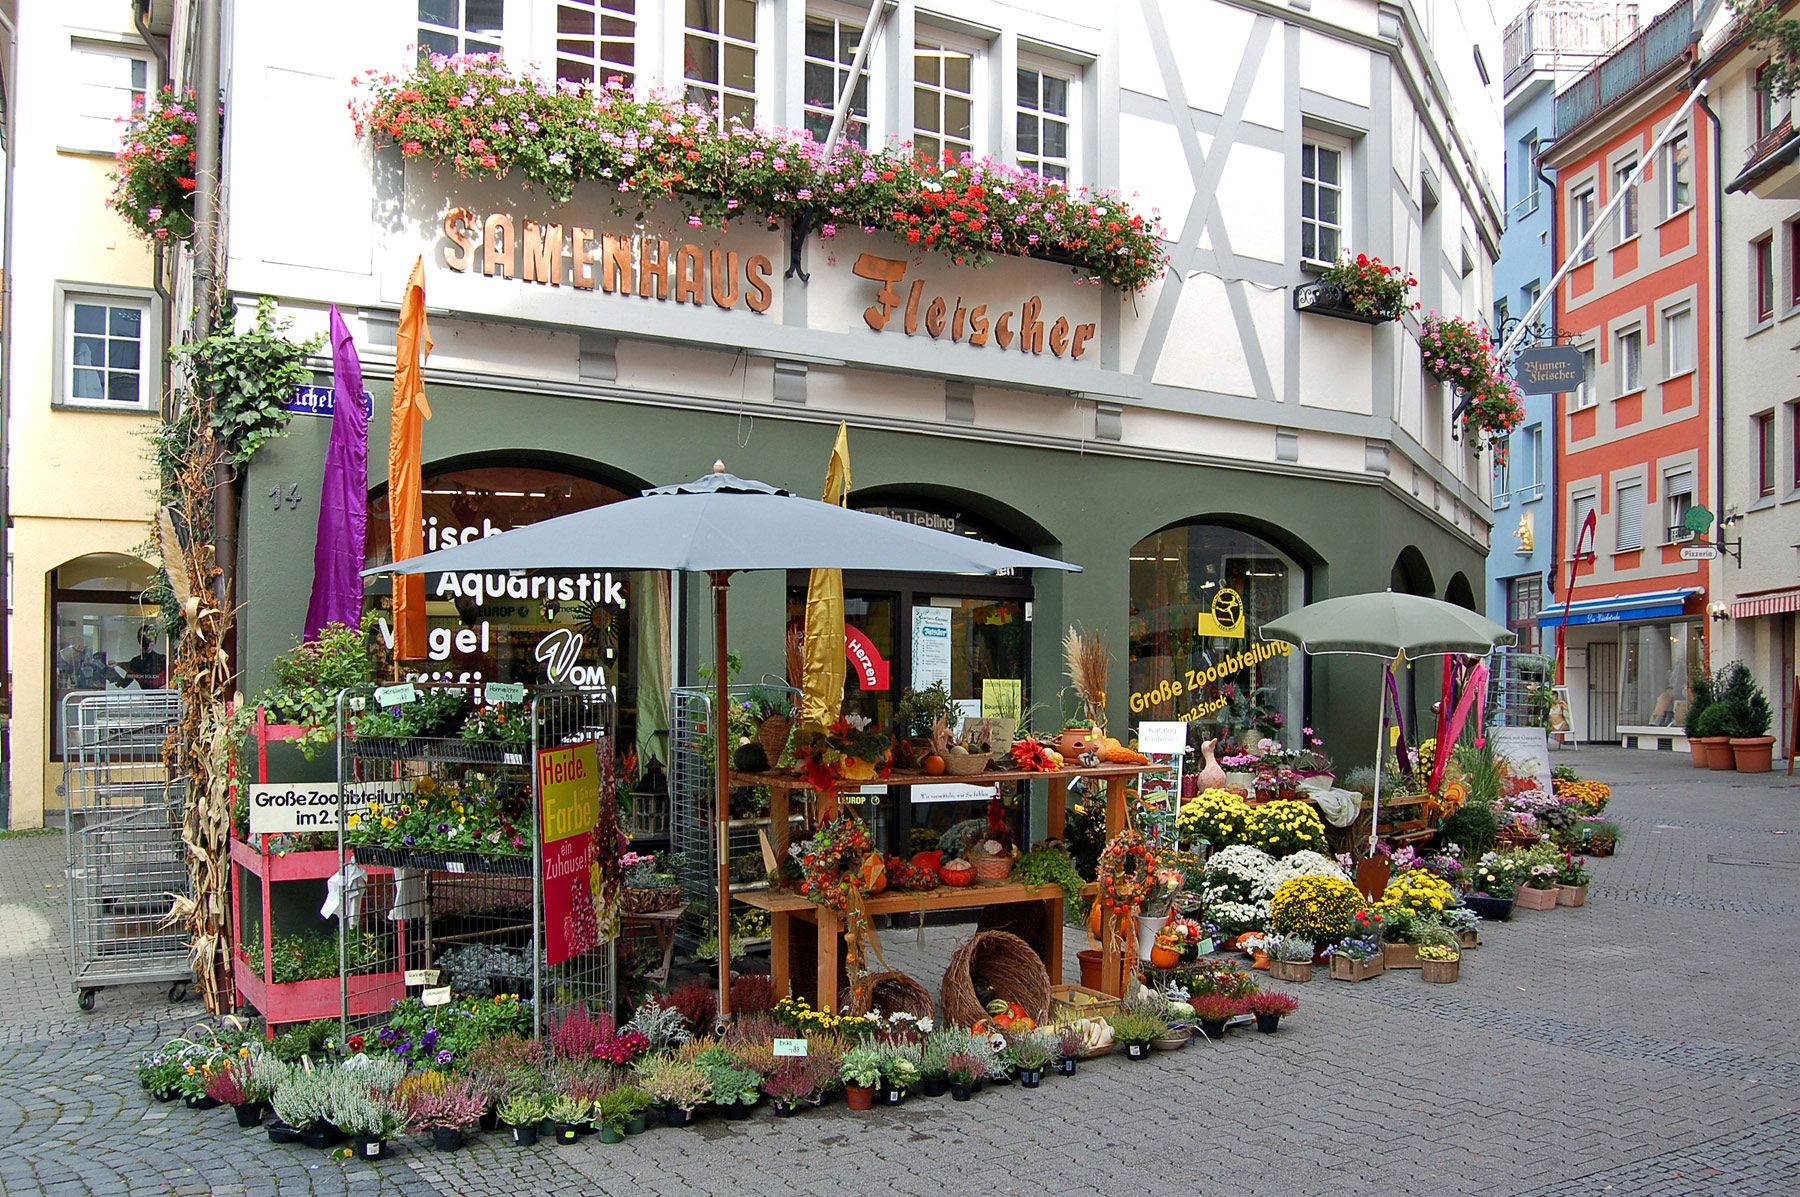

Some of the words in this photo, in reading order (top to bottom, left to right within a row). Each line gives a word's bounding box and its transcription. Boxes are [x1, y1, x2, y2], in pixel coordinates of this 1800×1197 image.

[443, 206, 773, 314] SAMENHAUS
[852, 252, 1096, 360] Fleischer
[1524, 361, 1571, 373] Blumen-
[1529, 369, 1576, 384] Fleischer
[268, 482, 302, 510] 14
[436, 572, 623, 606] Aquaristik
[378, 617, 489, 661] Vgel
[848, 639, 877, 686] Herzen
[1129, 680, 1183, 713] Große
[1185, 641, 1292, 692] Zooabteilung
[1148, 727, 1177, 735] Katalog
[542, 748, 587, 787] Heide.
[256, 791, 306, 808] Große
[546, 790, 591, 837] Farbe
[296, 811, 317, 826] im
[319, 809, 333, 825] 2.
[545, 847, 588, 881] Zuhause!
[560, 840, 572, 856] ein
